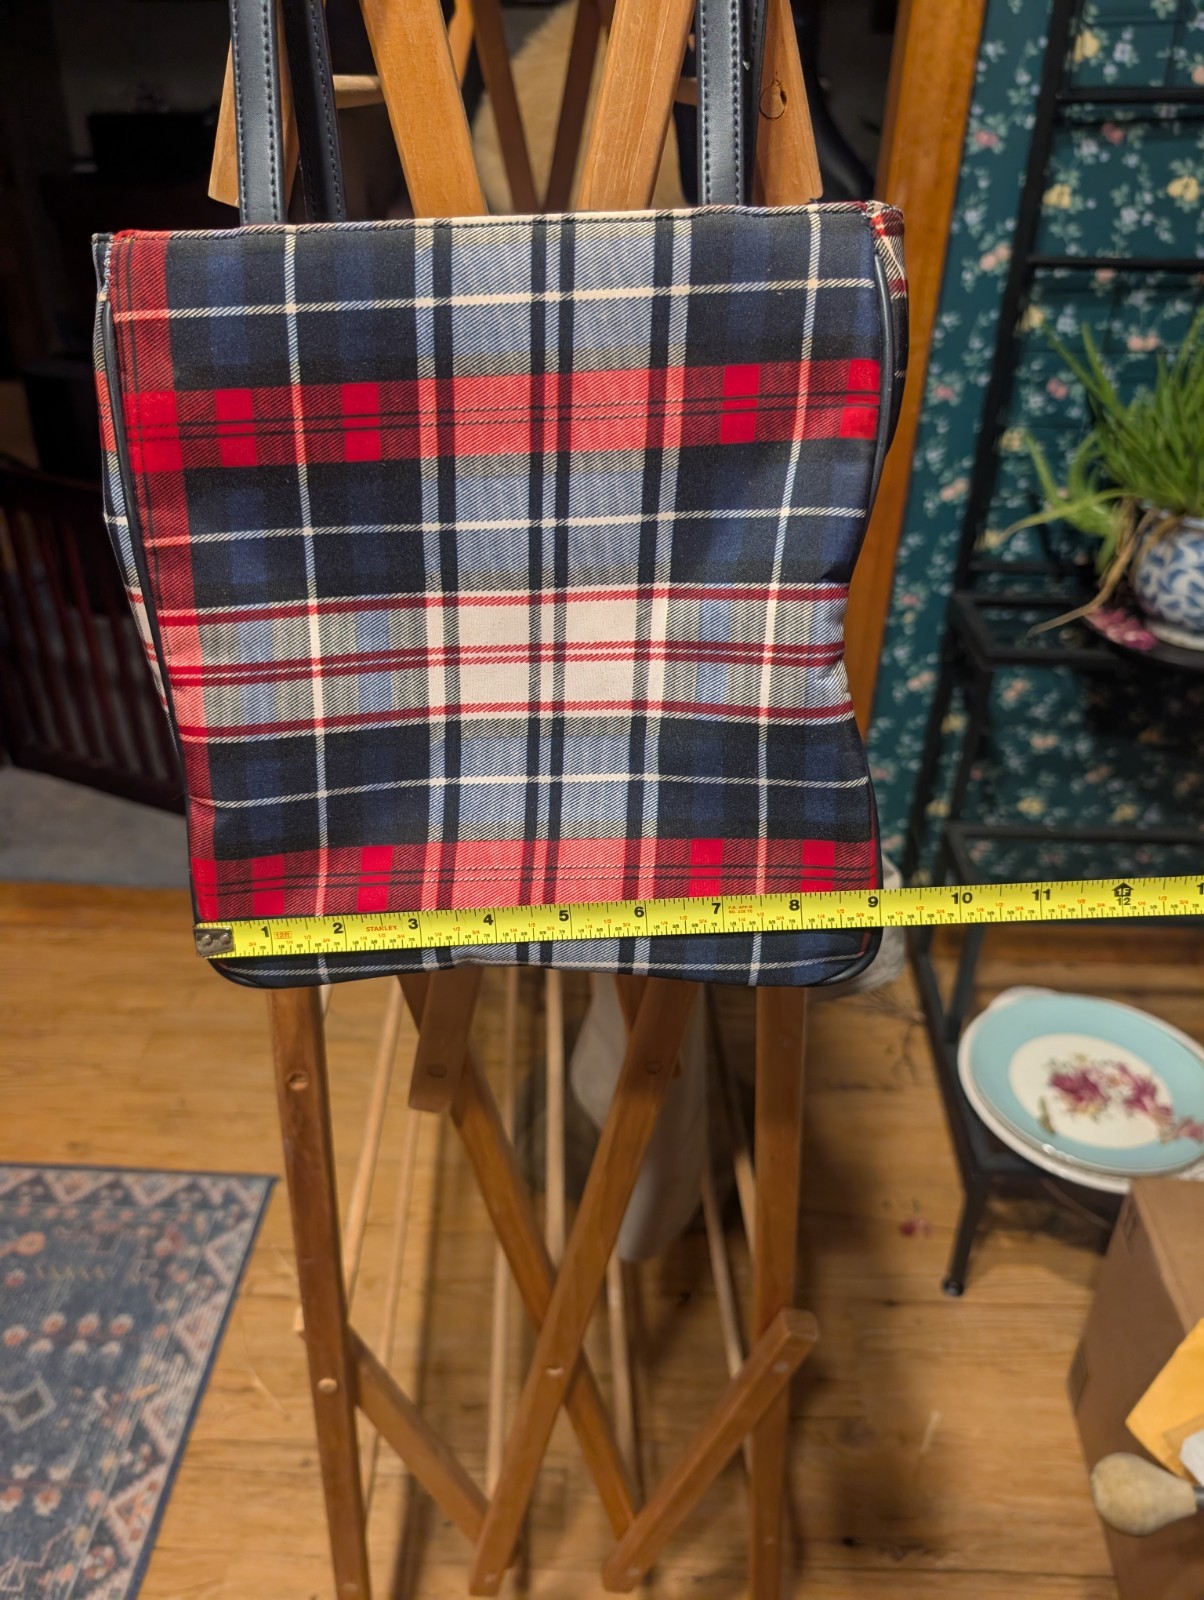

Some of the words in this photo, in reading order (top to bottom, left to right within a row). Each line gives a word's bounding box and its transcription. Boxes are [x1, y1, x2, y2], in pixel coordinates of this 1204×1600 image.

[261, 926, 269, 937] 1
[333, 923, 343, 934] 2
[408, 918, 418, 929] 3
[483, 914, 494, 925] 4
[559, 910, 569, 921] 5
[634, 907, 644, 918] 6
[712, 903, 721, 914] 7
[789, 900, 800, 911] 8
[868, 896, 878, 908] 9
[951, 892, 972, 904] 10
[1032, 889, 1050, 901] 11
[1117, 898, 1130, 906] 12
[1197, 883, 1204, 895] 1
